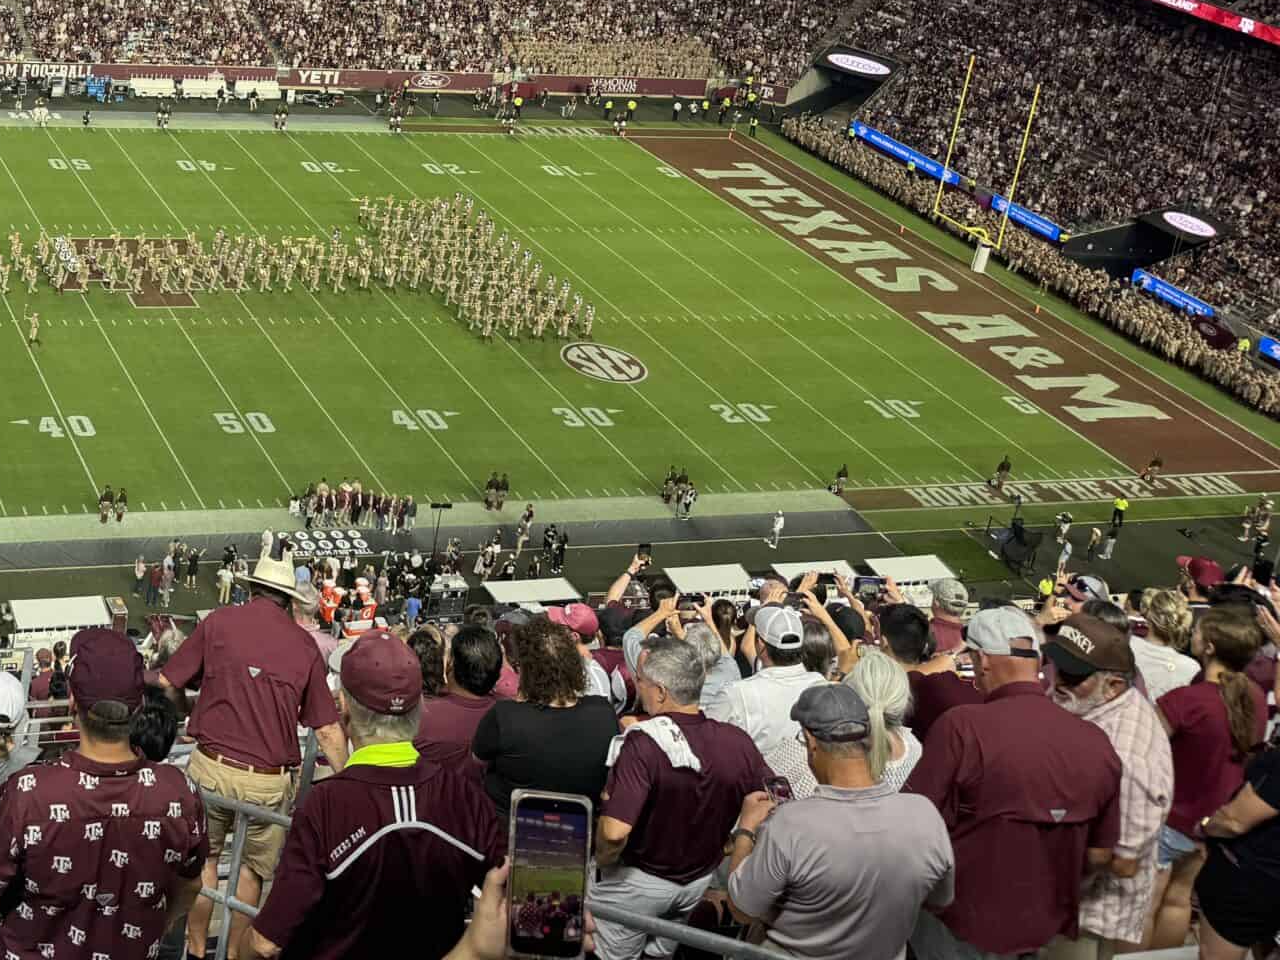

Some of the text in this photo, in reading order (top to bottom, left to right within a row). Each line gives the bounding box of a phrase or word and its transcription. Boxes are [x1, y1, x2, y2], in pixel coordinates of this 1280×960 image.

[22, 64, 94, 79] FOOTBALL
[298, 70, 339, 85] YETI
[48, 157, 92, 171] 50
[693, 161, 959, 293] TEXAS
[564, 342, 642, 382] SEC
[916, 311, 1173, 424] A&M
[391, 409, 449, 431] 40
[551, 407, 614, 427] 30
[709, 403, 771, 425] 20
[863, 399, 921, 419] 10
[38, 415, 96, 438] 40
[212, 411, 275, 434] 50
[904, 486, 1001, 508] HOME
[1000, 482, 1047, 503] OF
[1040, 481, 1112, 502] THE
[1162, 475, 1246, 496] MAN
